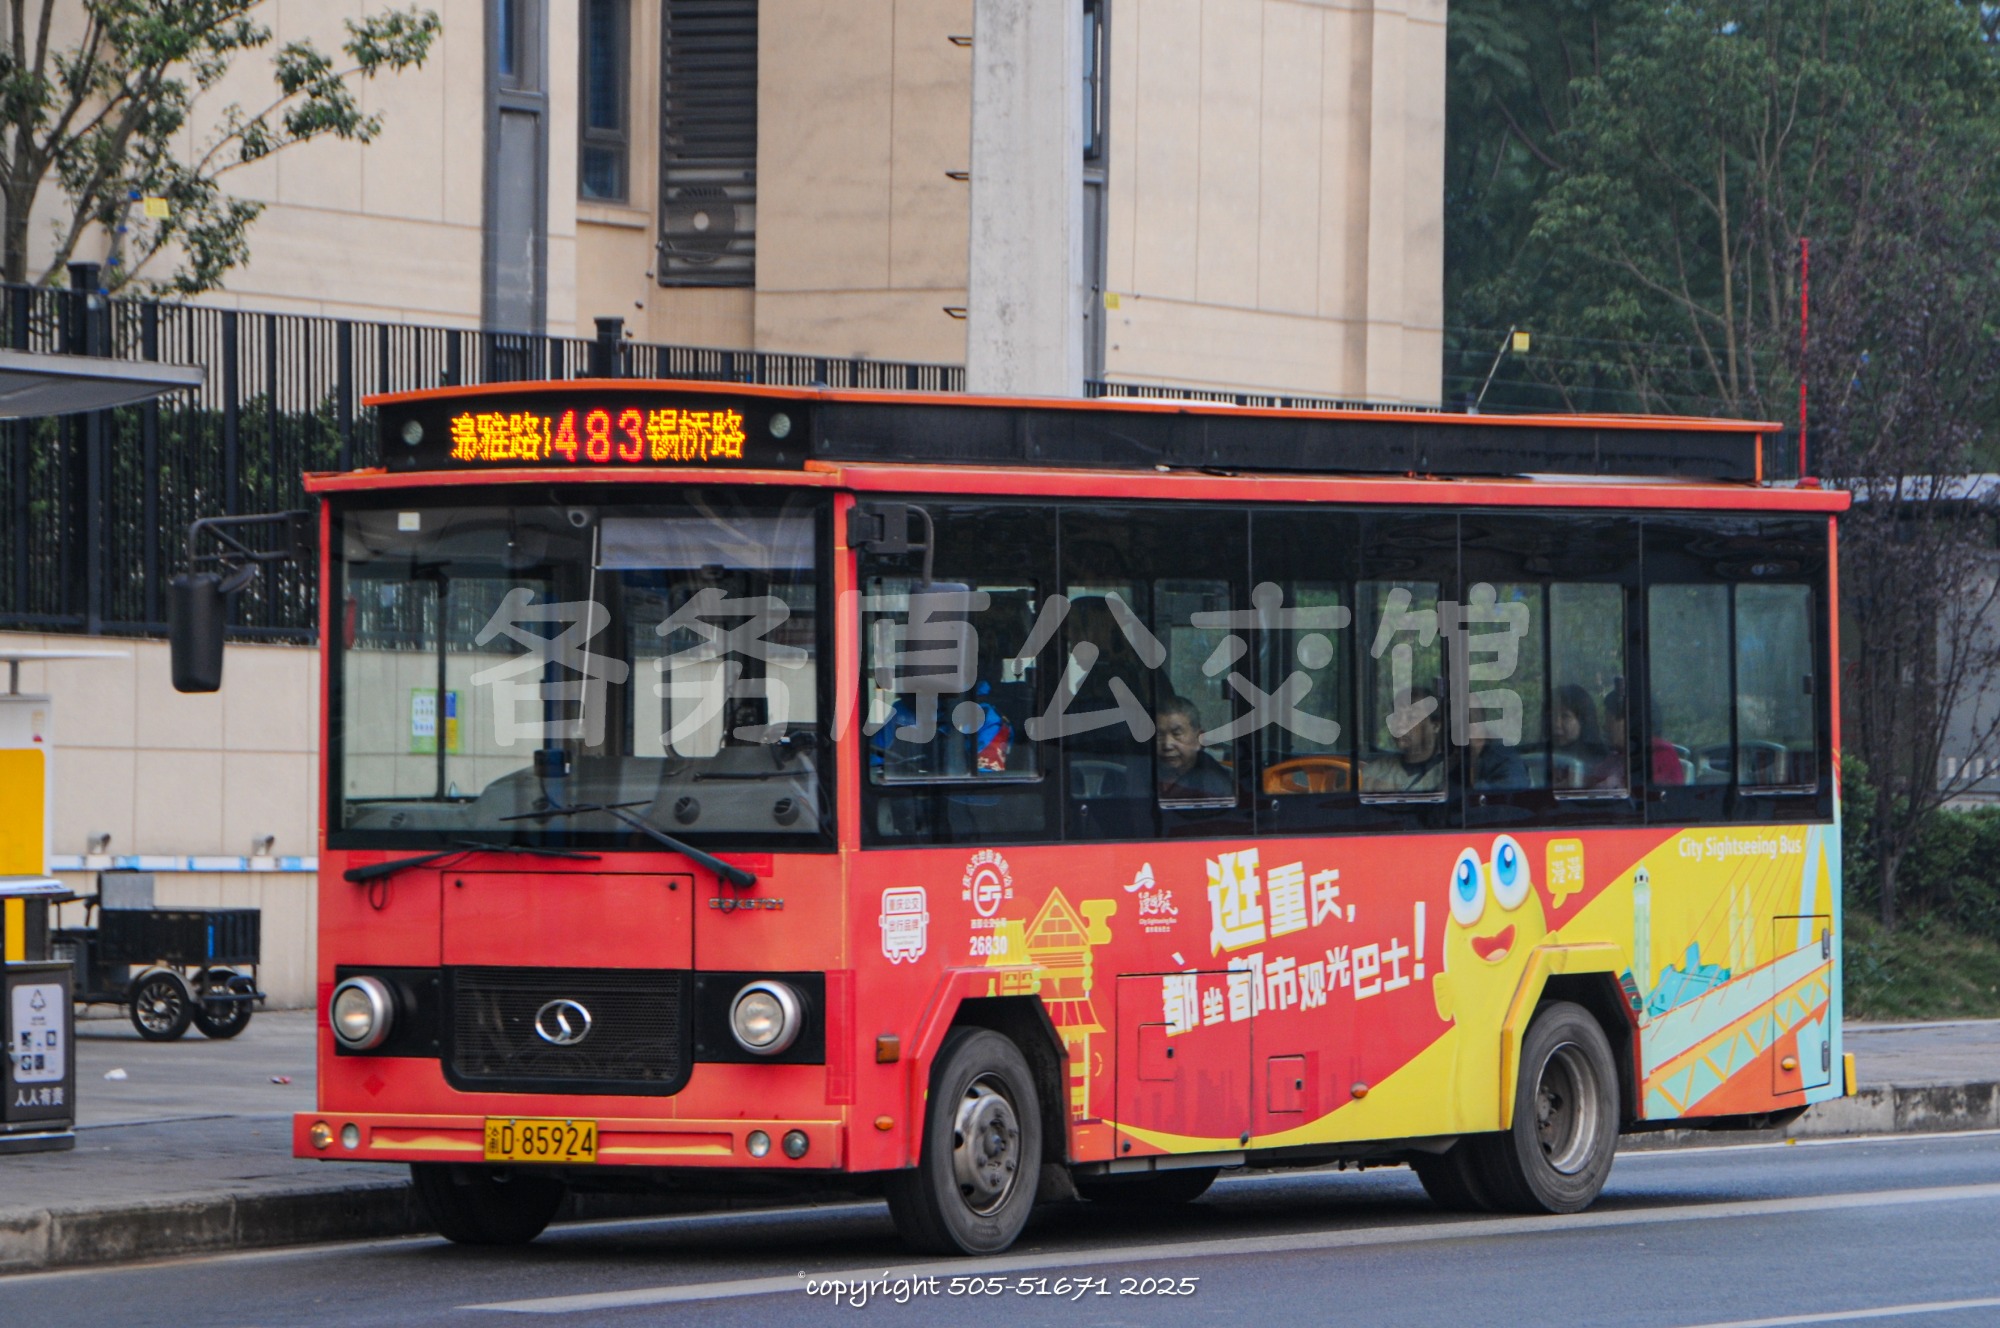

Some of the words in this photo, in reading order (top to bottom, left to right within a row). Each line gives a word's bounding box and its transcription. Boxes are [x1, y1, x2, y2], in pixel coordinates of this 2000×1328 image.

[555, 408, 644, 462] 483
[1680, 837, 1702, 862] City
[1706, 835, 1776, 861] Sightseeing
[1780, 835, 1802, 854] Bus
[969, 935, 1008, 956] 26830
